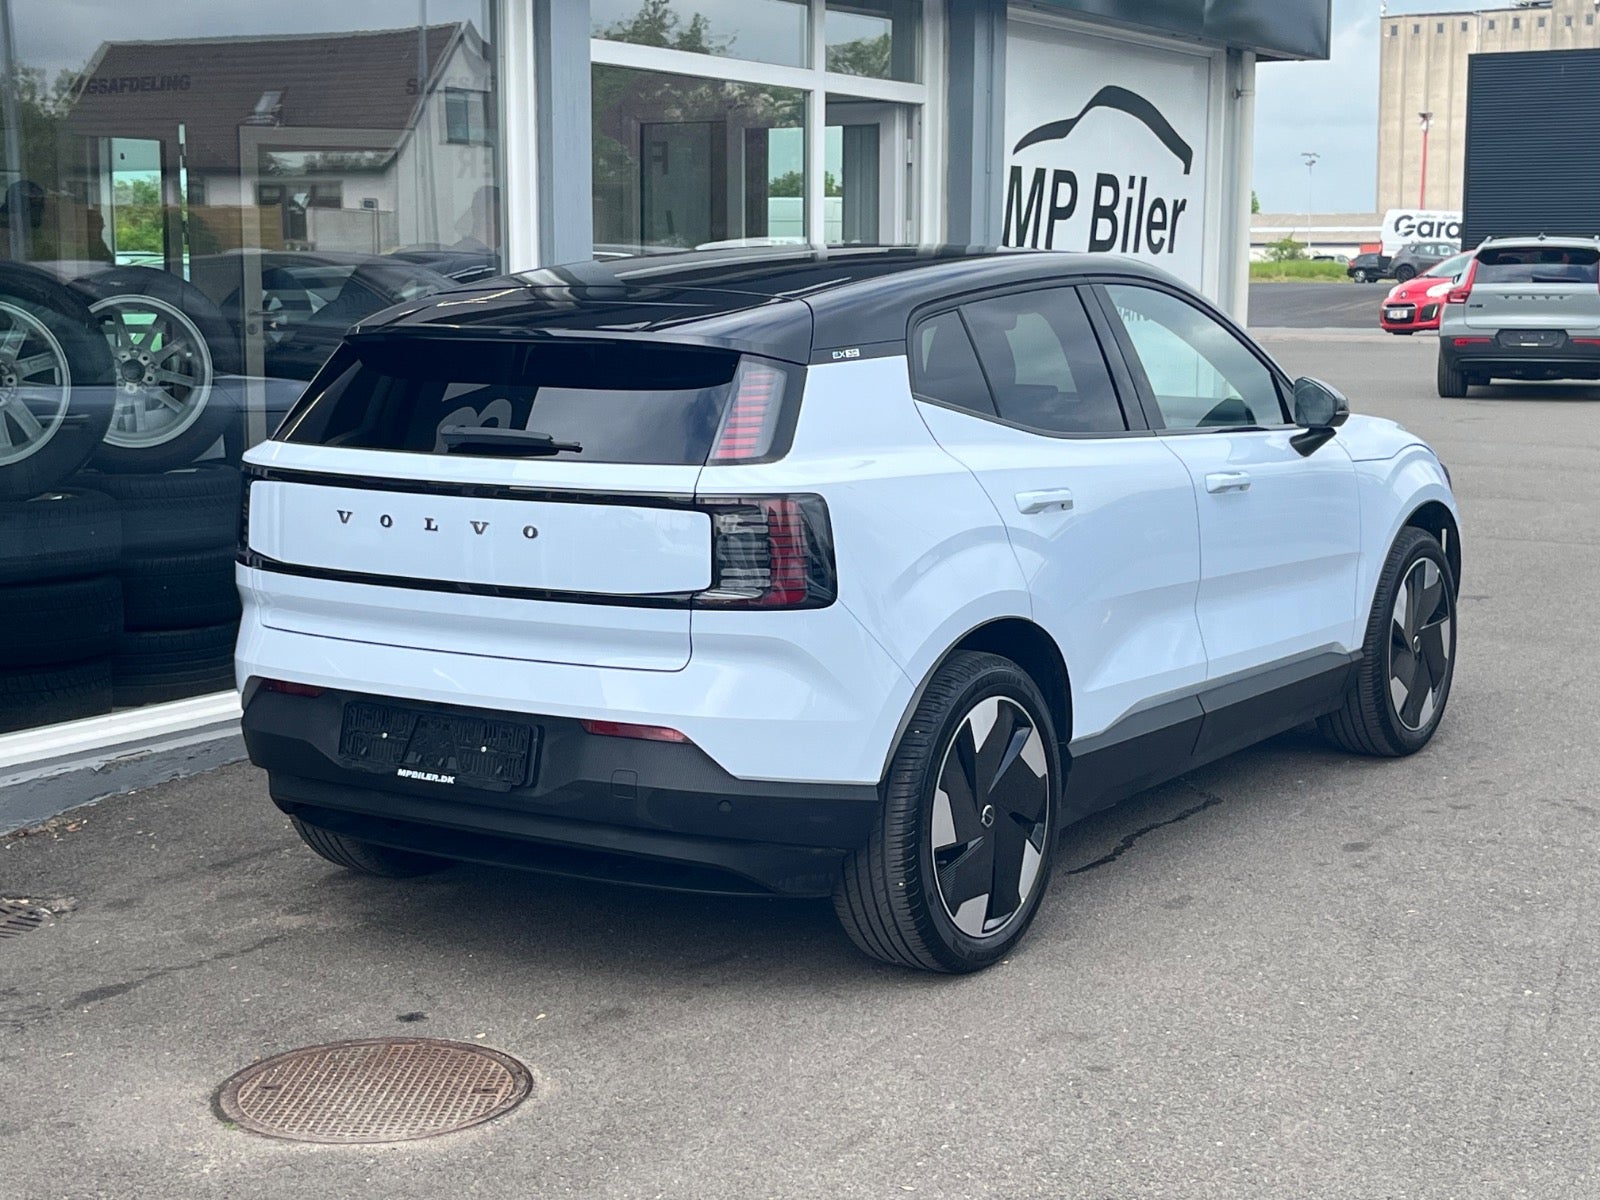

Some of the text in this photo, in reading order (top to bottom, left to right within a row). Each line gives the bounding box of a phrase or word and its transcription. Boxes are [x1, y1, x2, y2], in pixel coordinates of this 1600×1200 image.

[1002, 165, 1187, 254] MP Biler
[337, 509, 539, 539] VOLVO
[397, 768, 456, 784] MPBILER.DK
